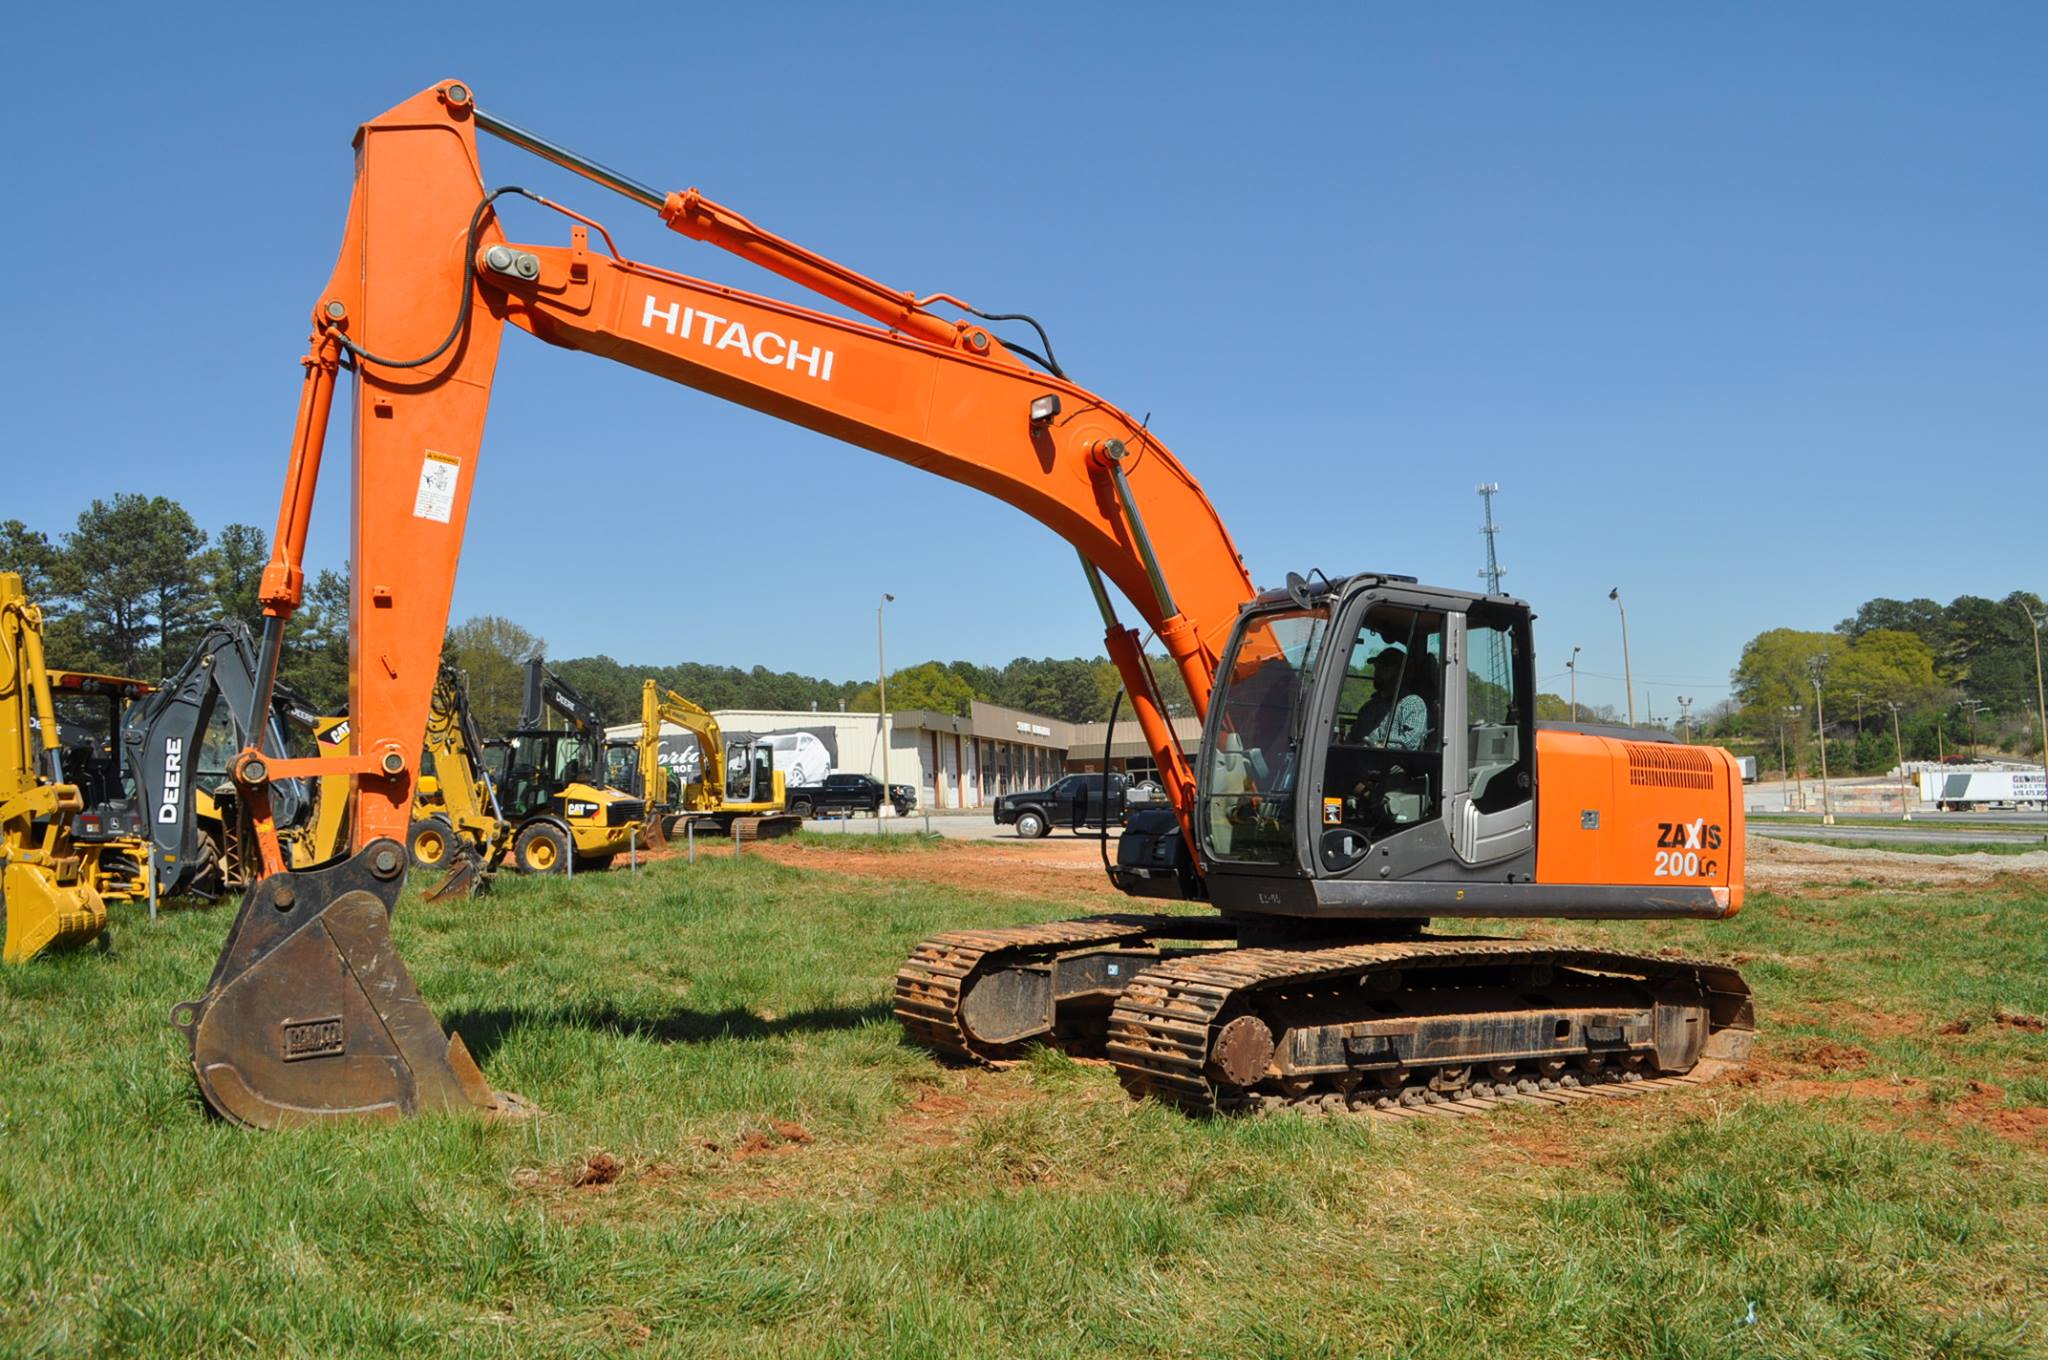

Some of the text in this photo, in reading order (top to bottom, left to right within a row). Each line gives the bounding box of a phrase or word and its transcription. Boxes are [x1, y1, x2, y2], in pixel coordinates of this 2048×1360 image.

[642, 295, 834, 381] HITACHI
[330, 720, 350, 744] CAT
[158, 738, 182, 824] DEERE
[568, 803, 585, 816] CAT
[1657, 818, 1721, 849] ZAXIS
